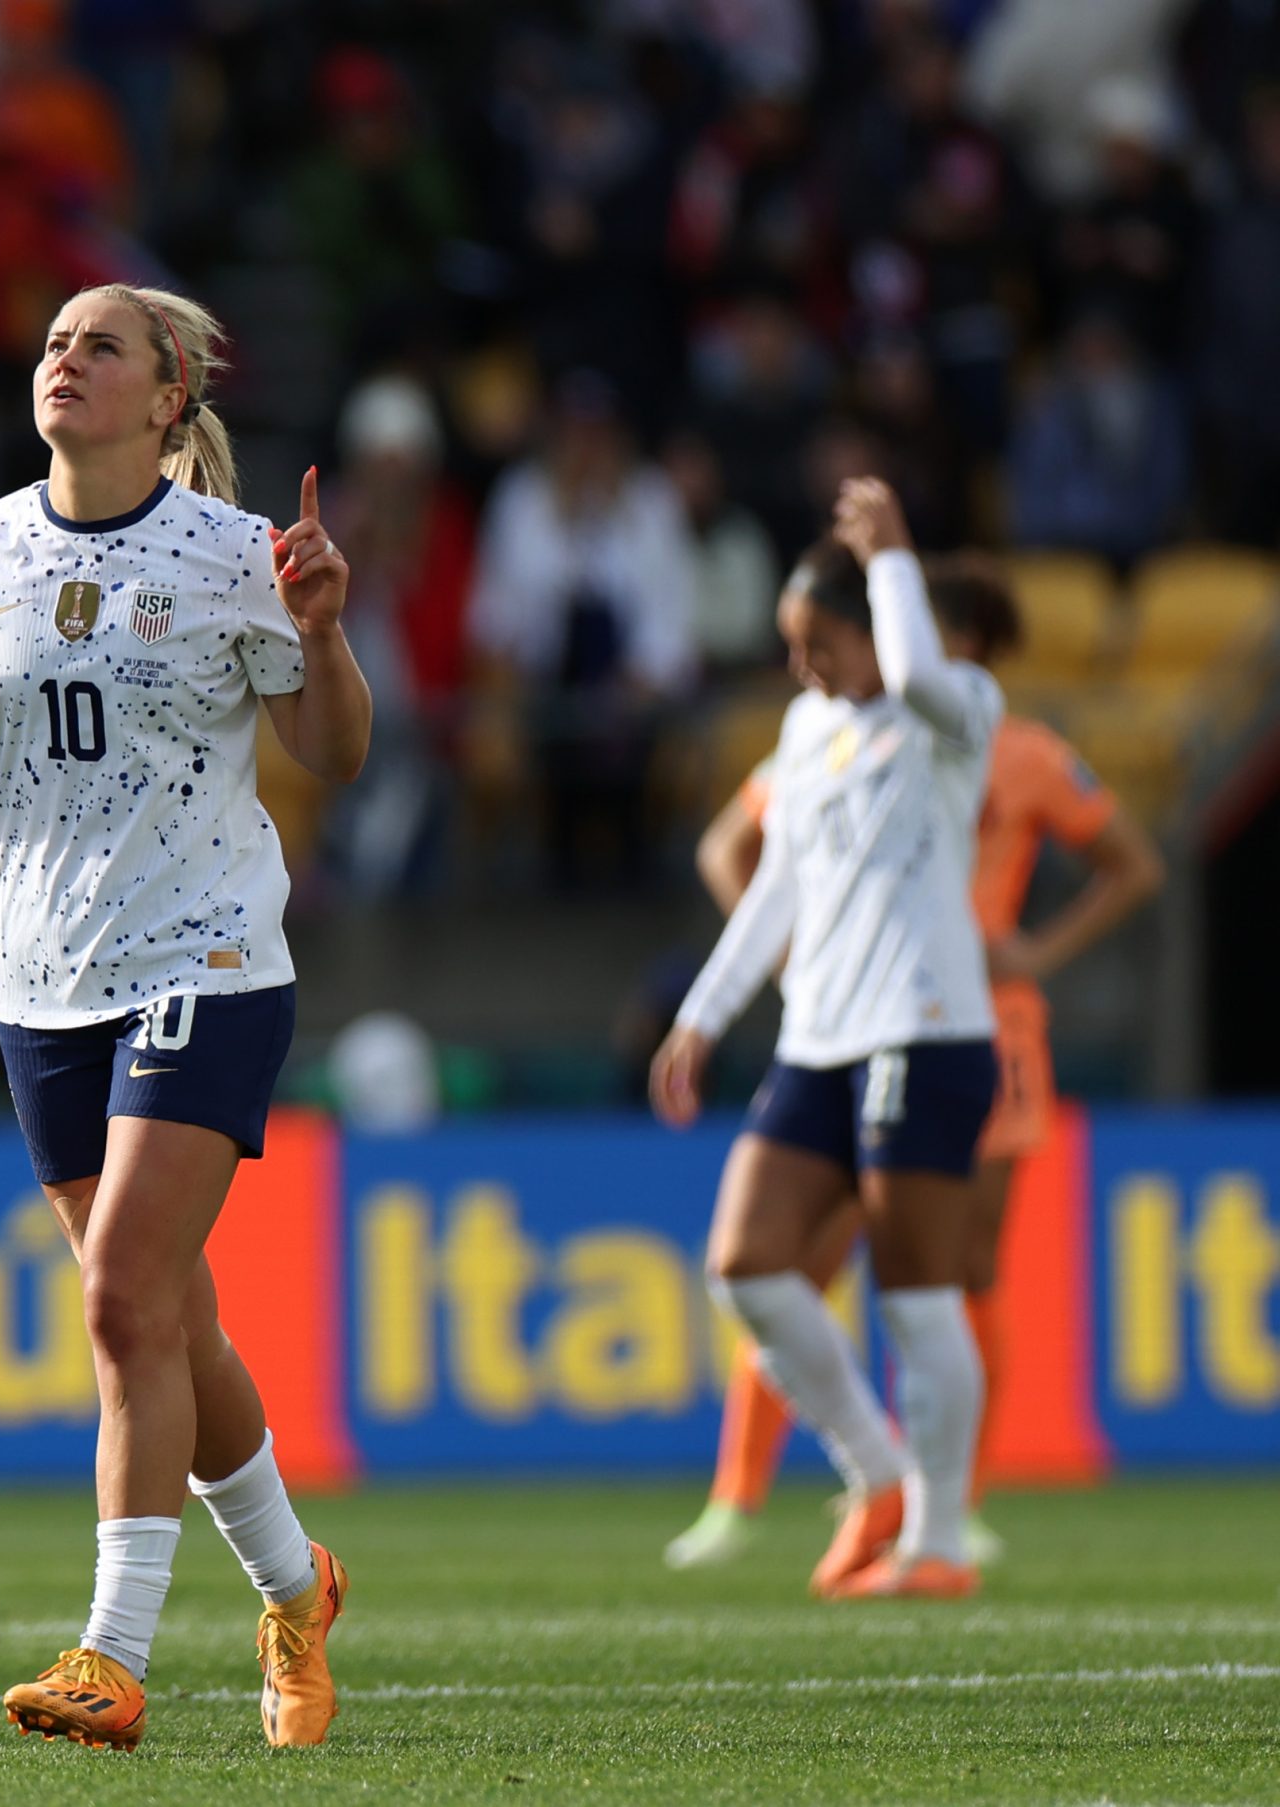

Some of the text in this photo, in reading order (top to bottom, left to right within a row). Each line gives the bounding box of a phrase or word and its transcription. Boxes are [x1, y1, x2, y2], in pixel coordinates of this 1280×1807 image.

[64, 618, 84, 628] FIFA
[136, 593, 173, 616] USA
[39, 678, 107, 762] 10
[129, 994, 197, 1051] 10
